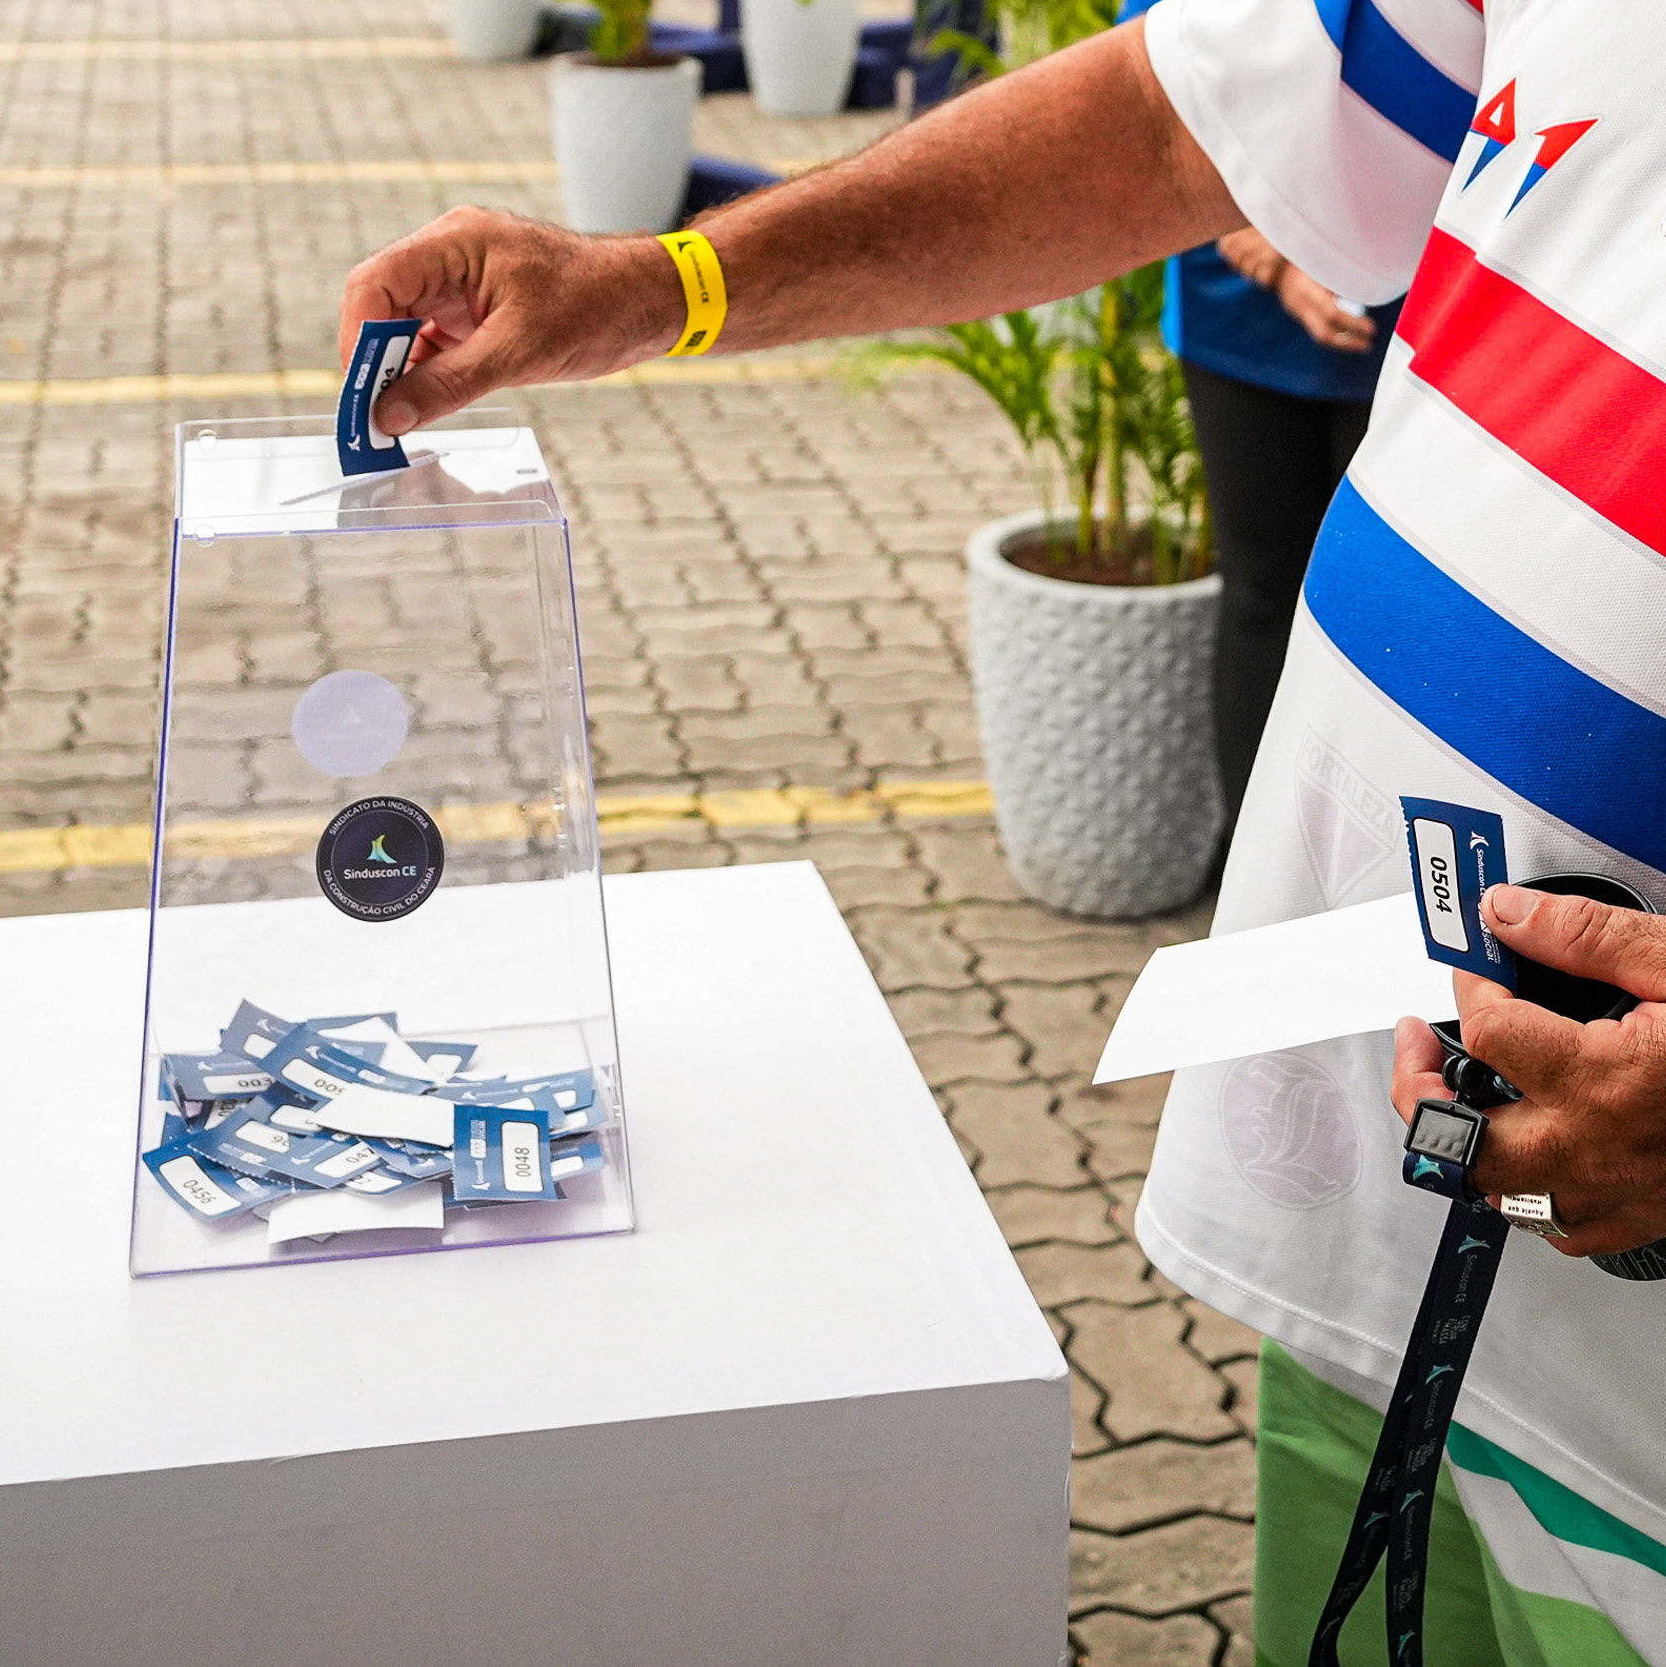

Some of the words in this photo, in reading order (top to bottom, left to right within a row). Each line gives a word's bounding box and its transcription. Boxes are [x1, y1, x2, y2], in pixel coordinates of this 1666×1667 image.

[329, 802, 371, 836] SINDICATO
[373, 800, 386, 808] DA
[344, 868, 400, 879] Sinduscon
[401, 866, 417, 877] CE
[1476, 848, 1486, 885] Sinduscon
[323, 869, 332, 884] DA
[329, 882, 381, 915] CONSTRUÇÃO
[383, 903, 406, 914] CIVIL
[404, 893, 418, 906] DO
[1431, 856, 1452, 914] 0504
[515, 1147, 531, 1178] 0048
[183, 1179, 217, 1204] 0456
[1461, 1253, 1477, 1291] Sinduscon
[1455, 1290, 1465, 1304] CE
